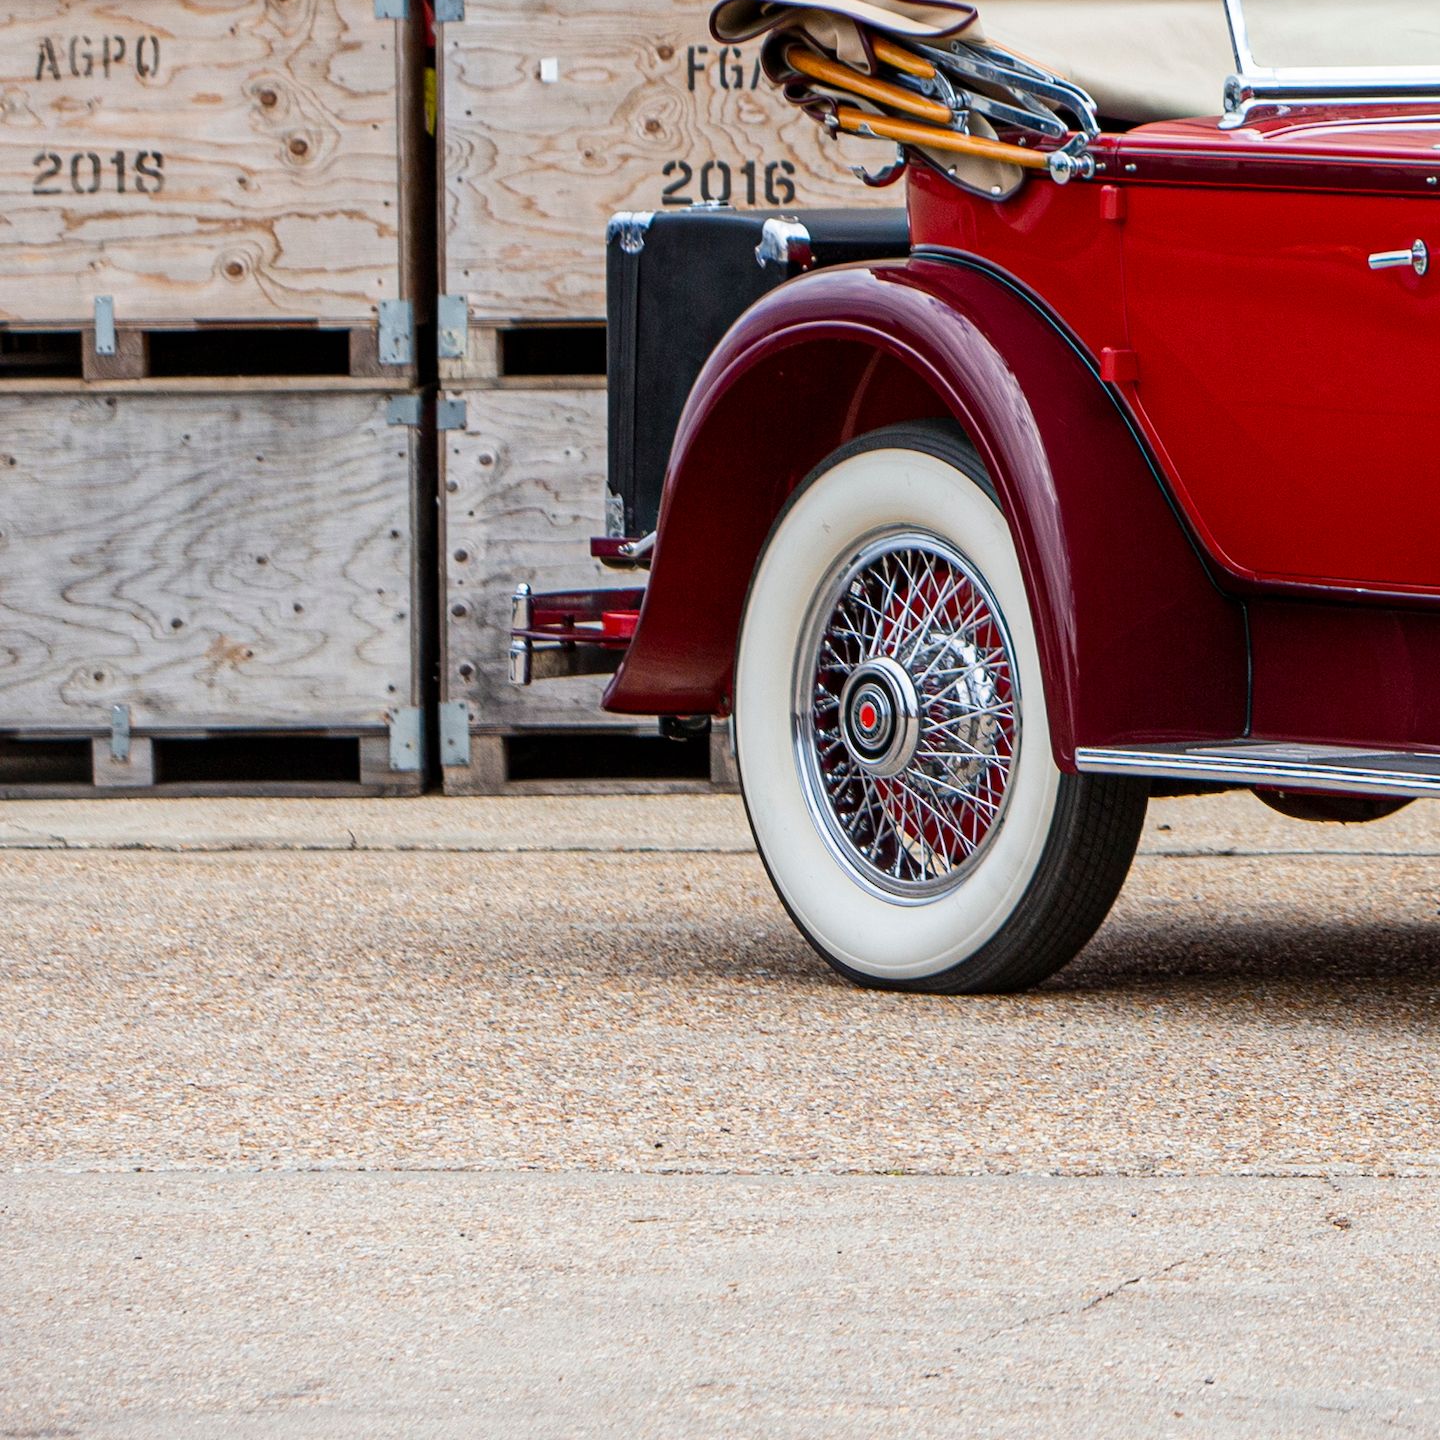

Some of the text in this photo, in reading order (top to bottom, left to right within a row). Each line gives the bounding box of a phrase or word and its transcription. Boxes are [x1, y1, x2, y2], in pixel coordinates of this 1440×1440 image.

[36, 36, 161, 80] AGPO
[32, 151, 166, 196] 2018
[662, 160, 795, 205] 2016
